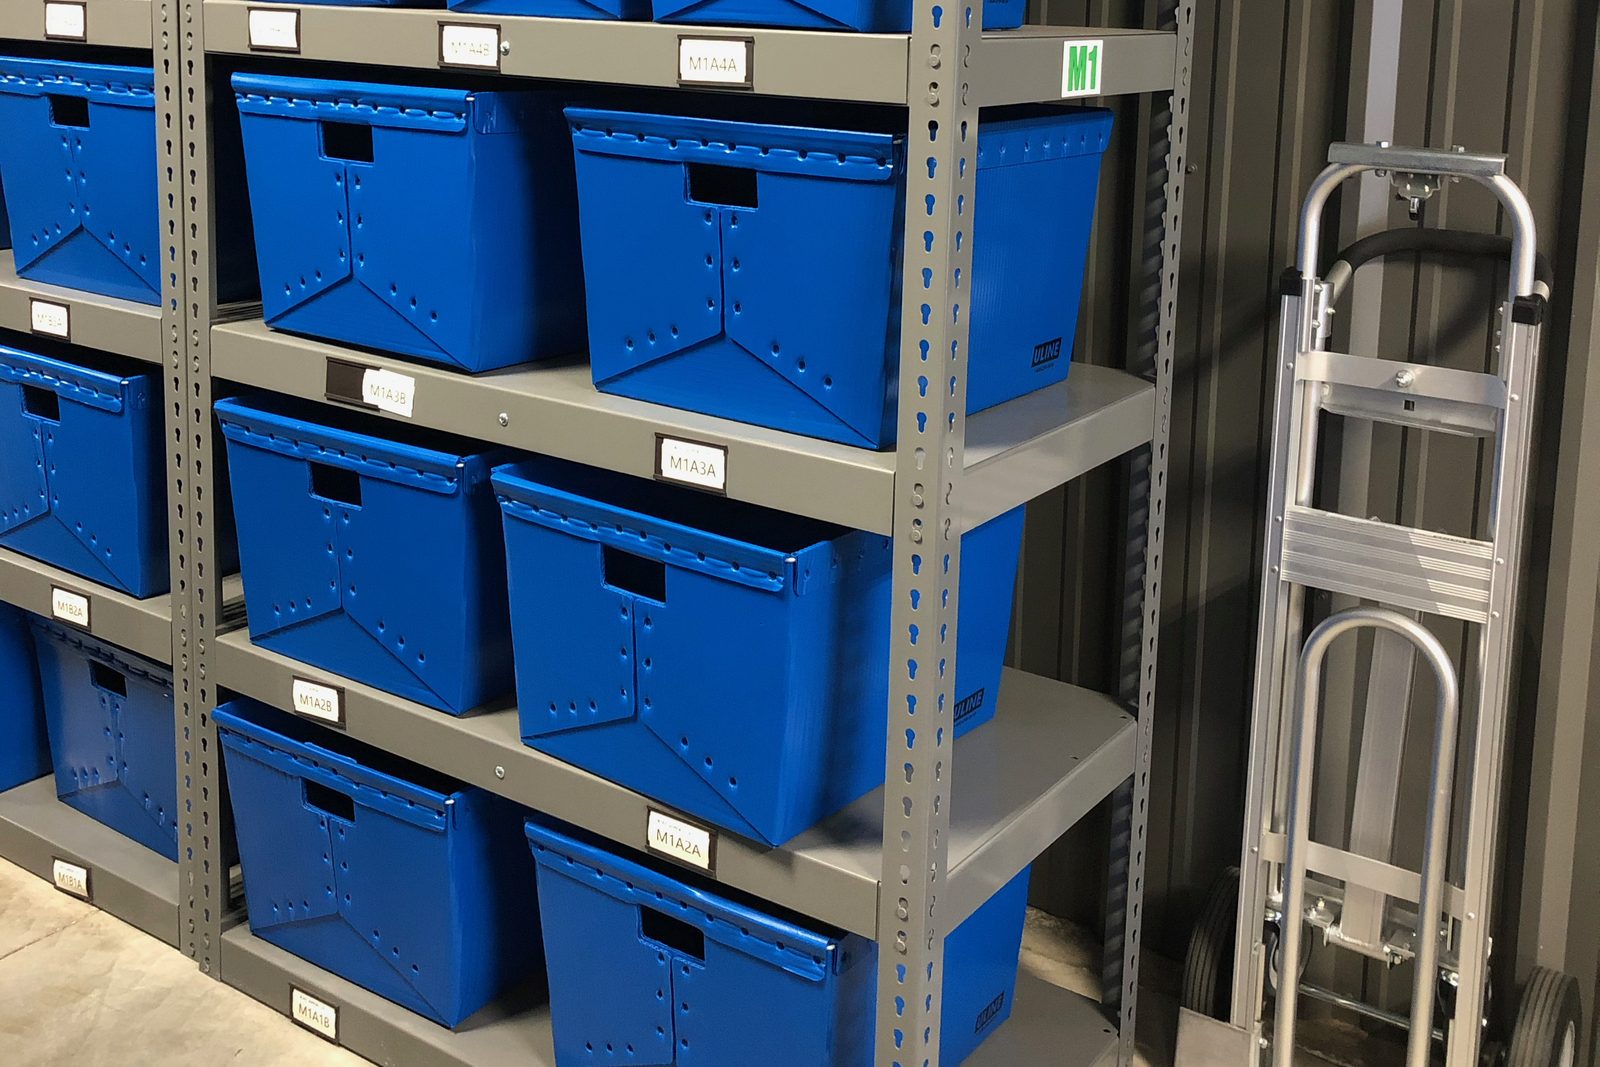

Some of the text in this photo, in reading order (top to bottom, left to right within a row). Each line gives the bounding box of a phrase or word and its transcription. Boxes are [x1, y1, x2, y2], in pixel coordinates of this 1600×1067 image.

[689, 56, 737, 72] M1A4A
[1067, 45, 1098, 92] M1
[1033, 340, 1060, 363] ULINE
[370, 384, 406, 405] M1A3B
[670, 455, 716, 478] M1A3A
[57, 600, 83, 617] M1B2A
[299, 693, 332, 712] M1A2B
[954, 690, 983, 719] ULINE
[656, 828, 701, 858] M1A2A
[58, 872, 83, 890] M1B1A
[298, 1003, 330, 1029] M1A1B
